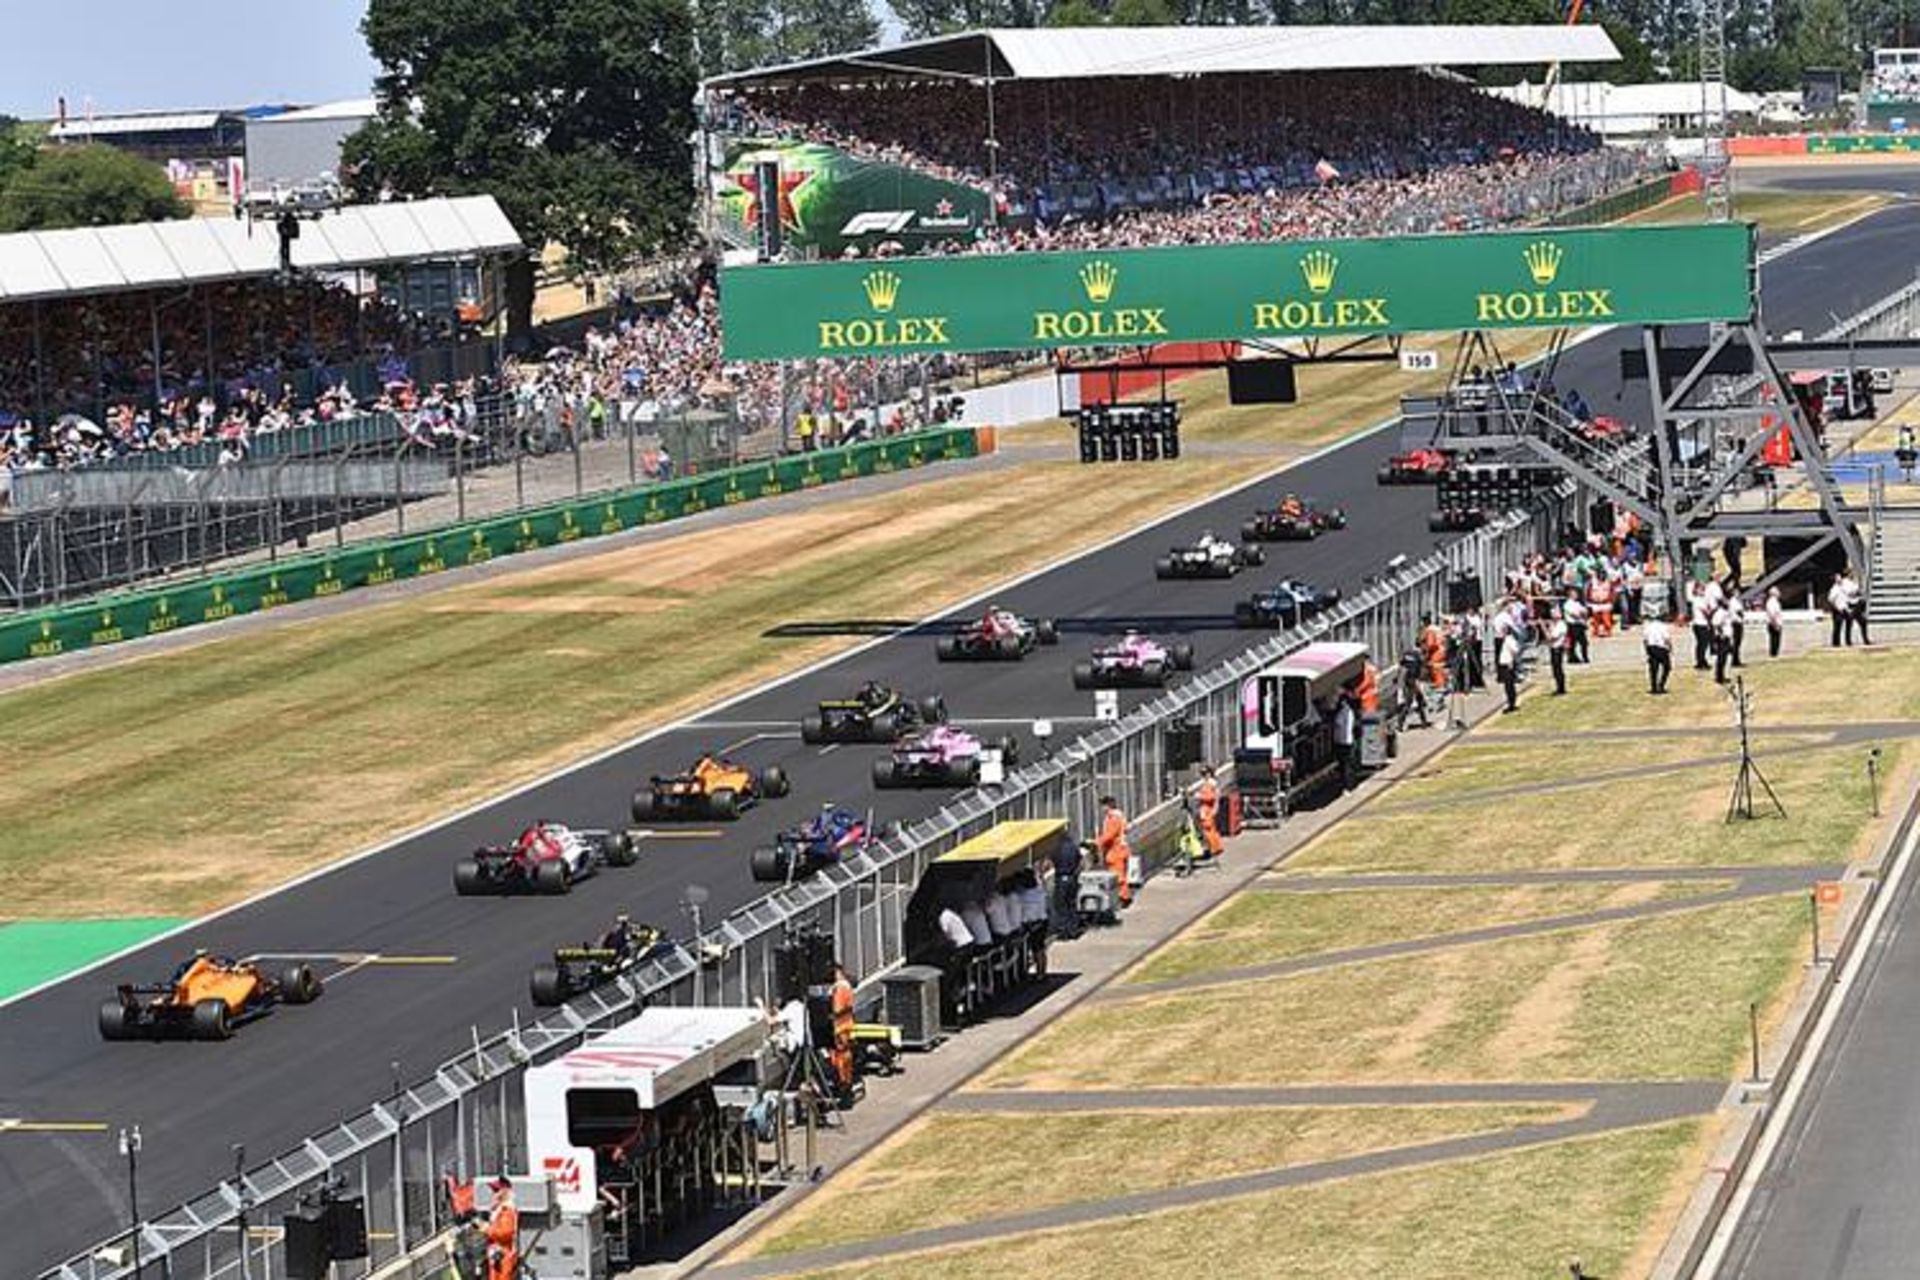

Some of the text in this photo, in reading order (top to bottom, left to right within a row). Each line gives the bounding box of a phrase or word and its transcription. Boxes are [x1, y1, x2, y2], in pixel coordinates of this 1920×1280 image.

[840, 210, 917, 236] F1
[1253, 299, 1390, 330] ROLEX
[1476, 289, 1615, 321] ROLEX
[818, 317, 950, 348] ROLEX
[1034, 308, 1168, 339] ROLEX
[1408, 355, 1432, 368] 150
